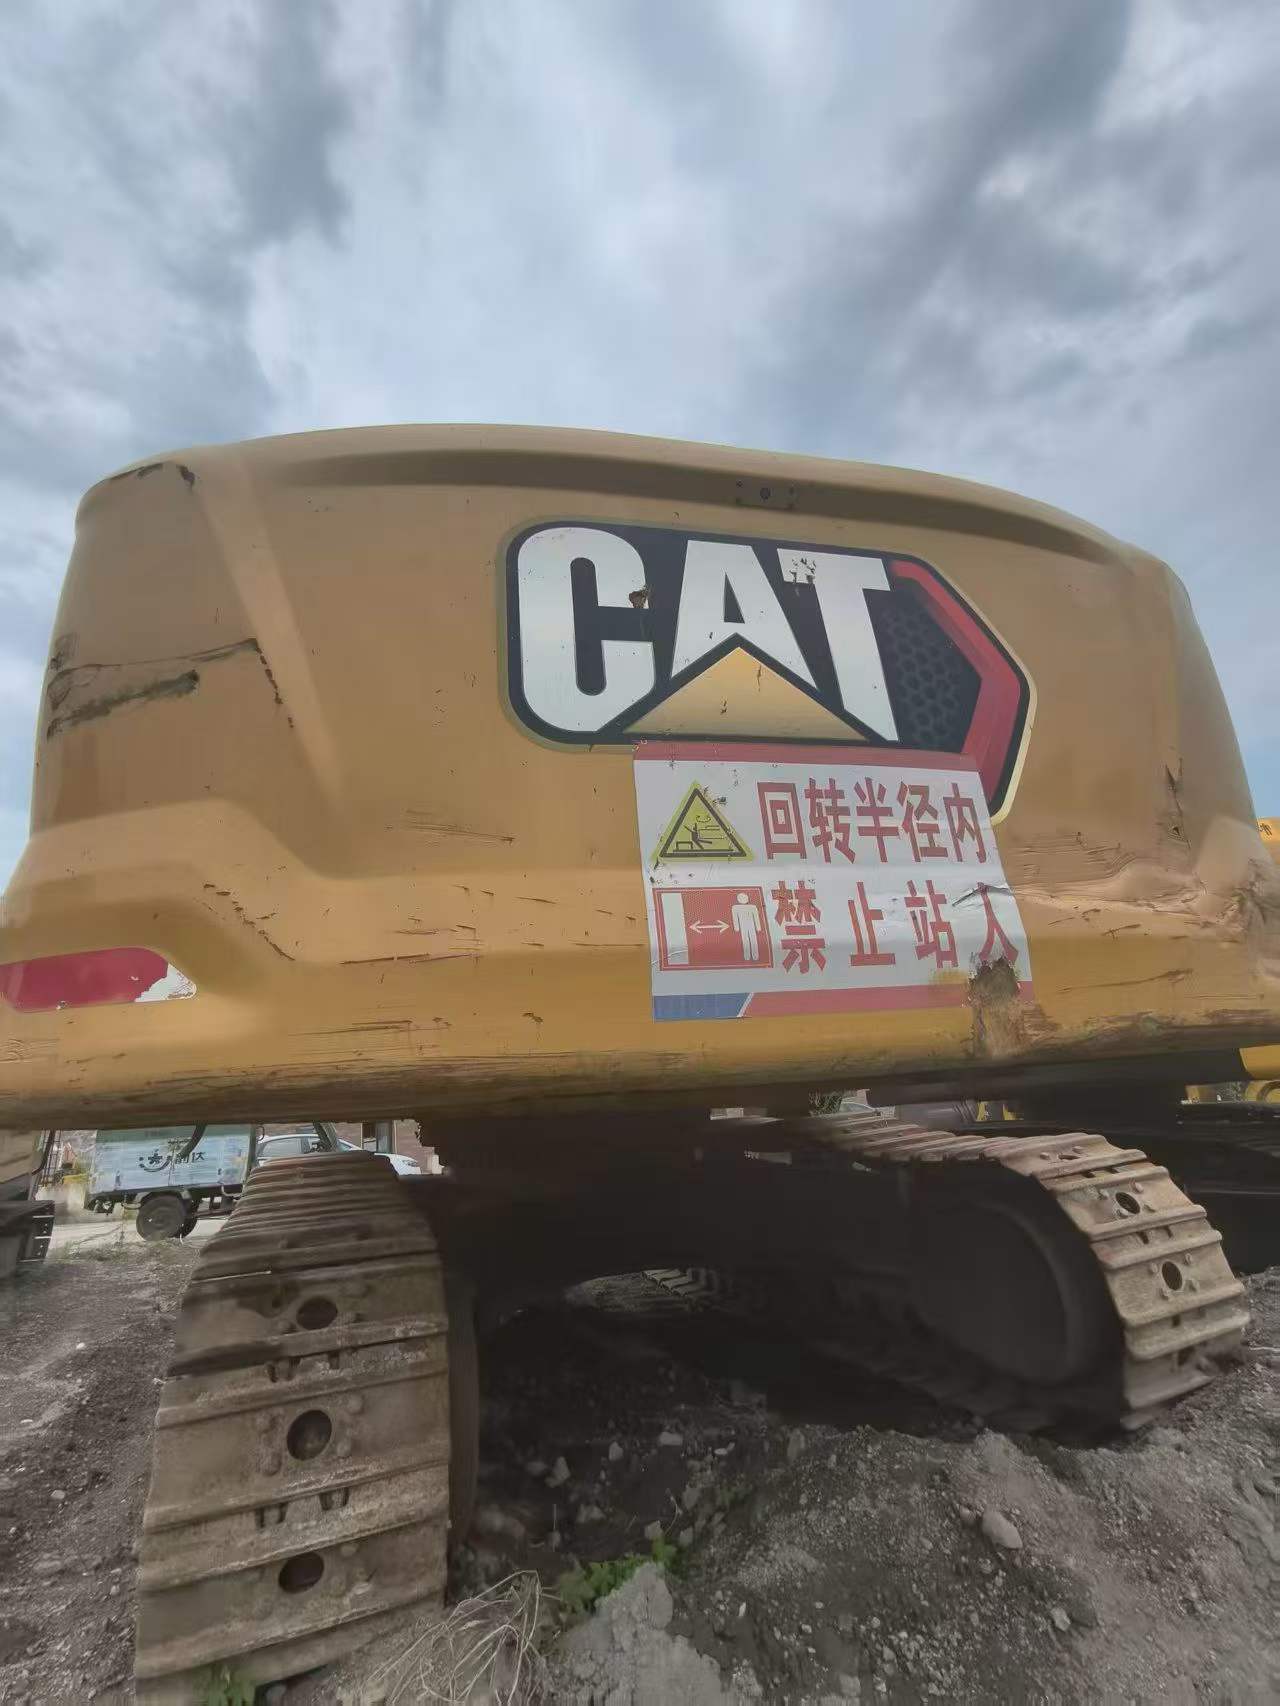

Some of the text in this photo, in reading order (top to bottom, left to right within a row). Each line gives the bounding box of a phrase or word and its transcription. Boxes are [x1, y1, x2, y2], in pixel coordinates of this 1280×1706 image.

[517, 527, 899, 741] CAT
[757, 777, 987, 864] 回转半径内
[771, 880, 1019, 974] 禁止站人
